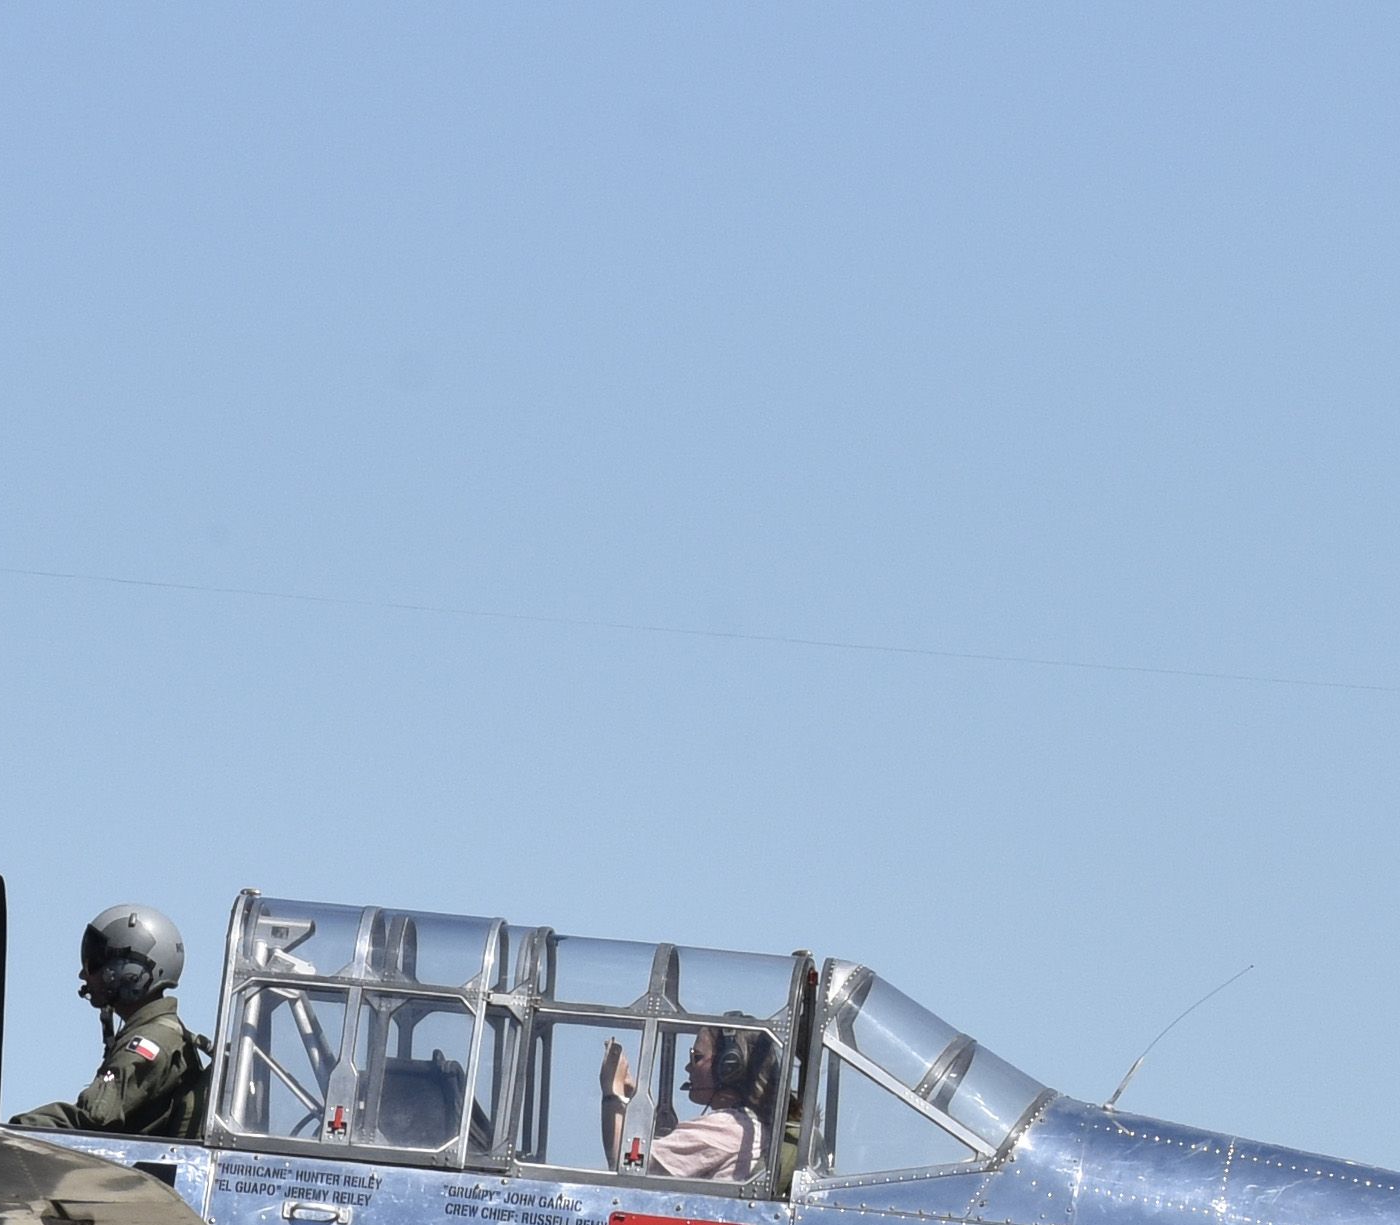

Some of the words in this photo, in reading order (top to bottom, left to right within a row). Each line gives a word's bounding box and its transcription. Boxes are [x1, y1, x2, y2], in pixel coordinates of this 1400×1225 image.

[217, 1162, 292, 1180] "HURRICANE"
[295, 1170, 340, 1186] HUNTER
[343, 1174, 383, 1191] REILEY
[215, 1179, 232, 1192] "EL
[235, 1181, 281, 1196] GUAPO"
[284, 1187, 329, 1202] JEREMY
[332, 1191, 373, 1207] REILEY
[443, 1184, 501, 1202] "GRUMPY"
[503, 1191, 536, 1207] JOHN
[538, 1195, 583, 1213] GARRIC
[445, 1203, 479, 1218] CREW
[480, 1207, 519, 1223] CHIEF:
